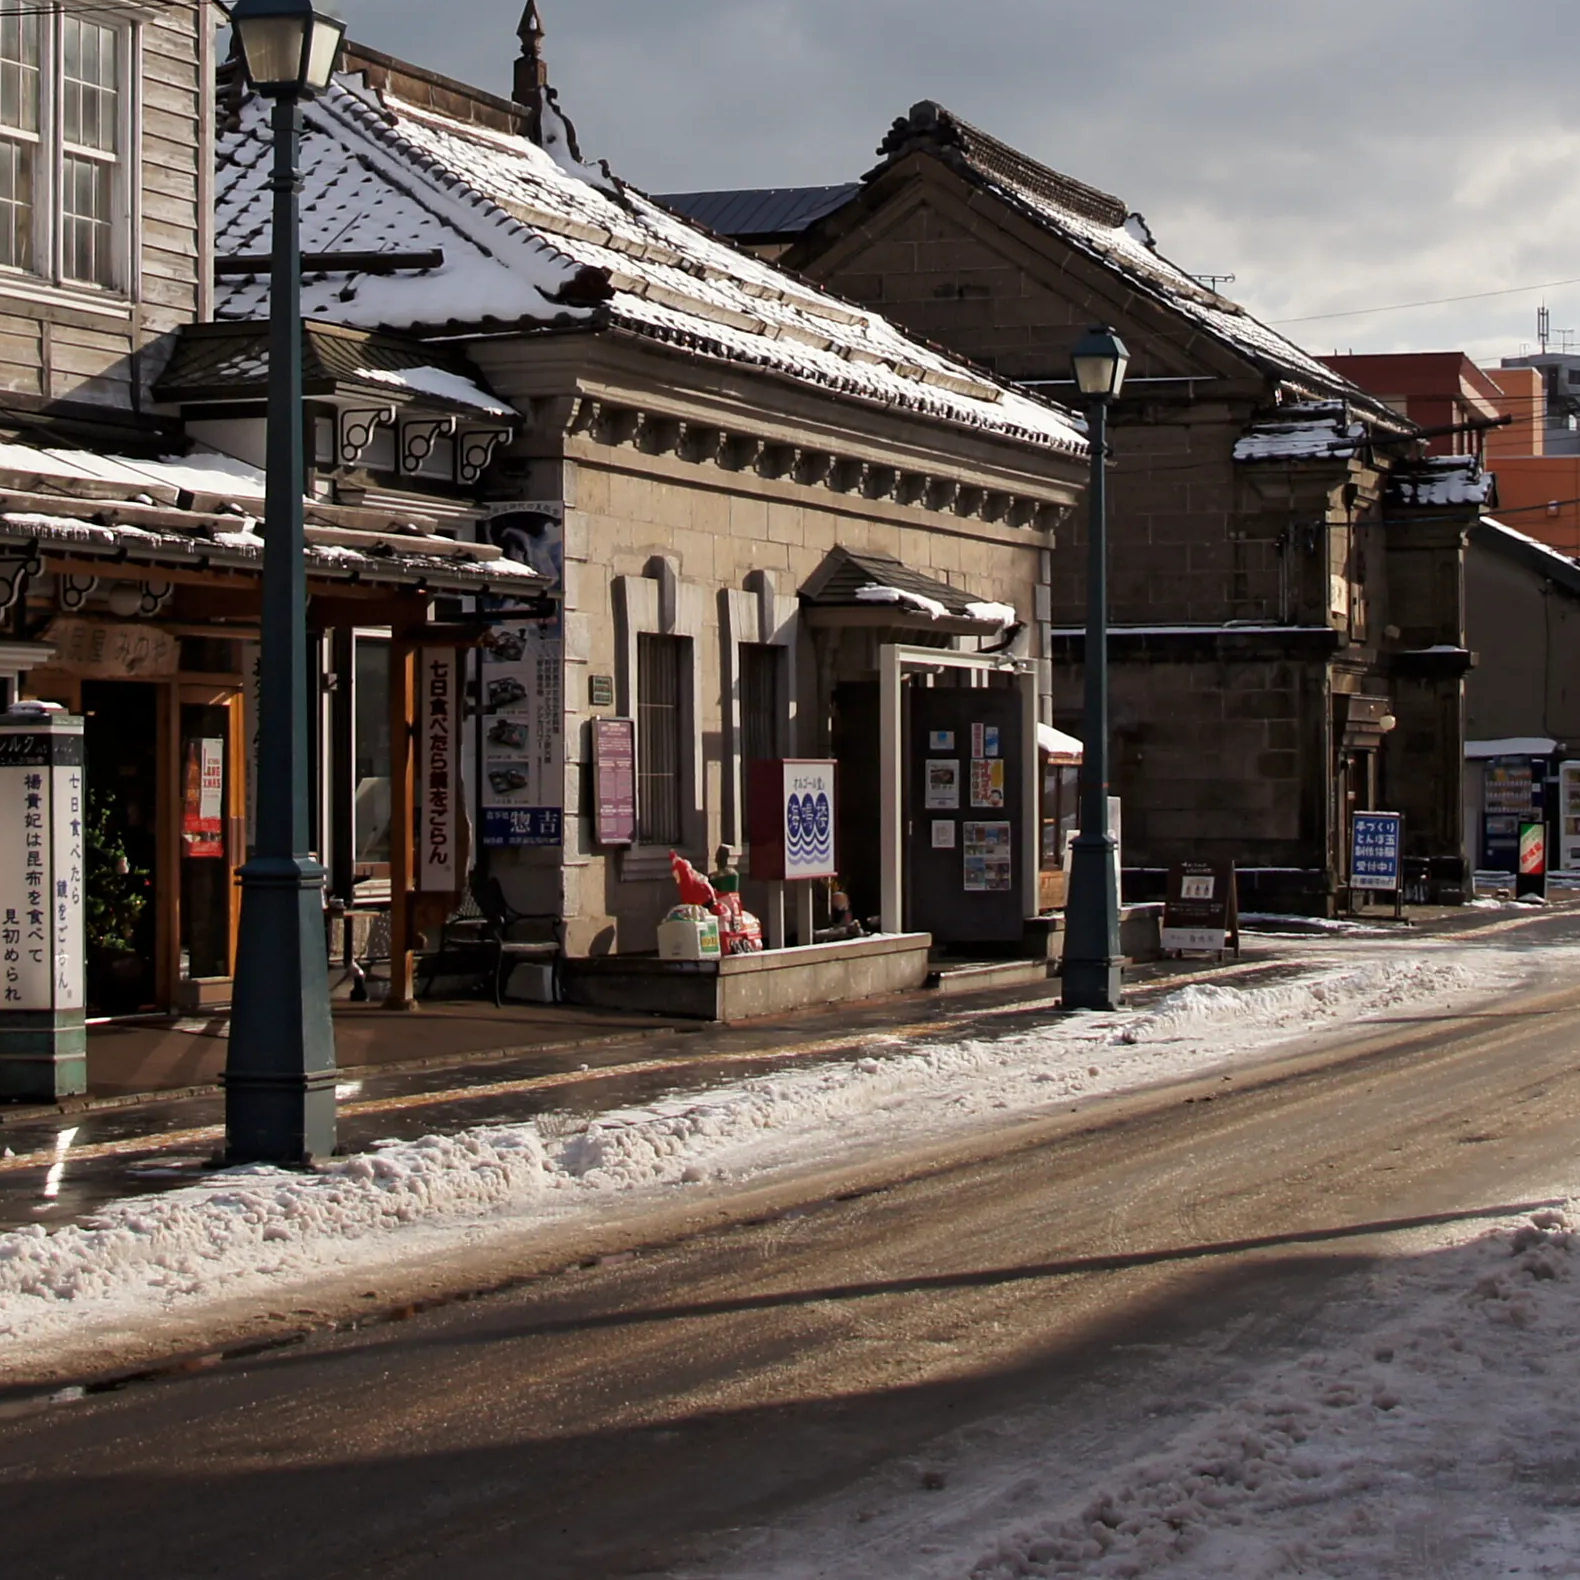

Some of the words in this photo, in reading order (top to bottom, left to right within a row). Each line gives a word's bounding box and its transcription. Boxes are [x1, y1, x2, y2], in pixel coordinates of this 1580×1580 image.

[429, 659, 449, 865] 七日食べたら鏡をごらん
[69, 773, 82, 905] 七日食べたら
[2, 908, 22, 1001] 見初められ
